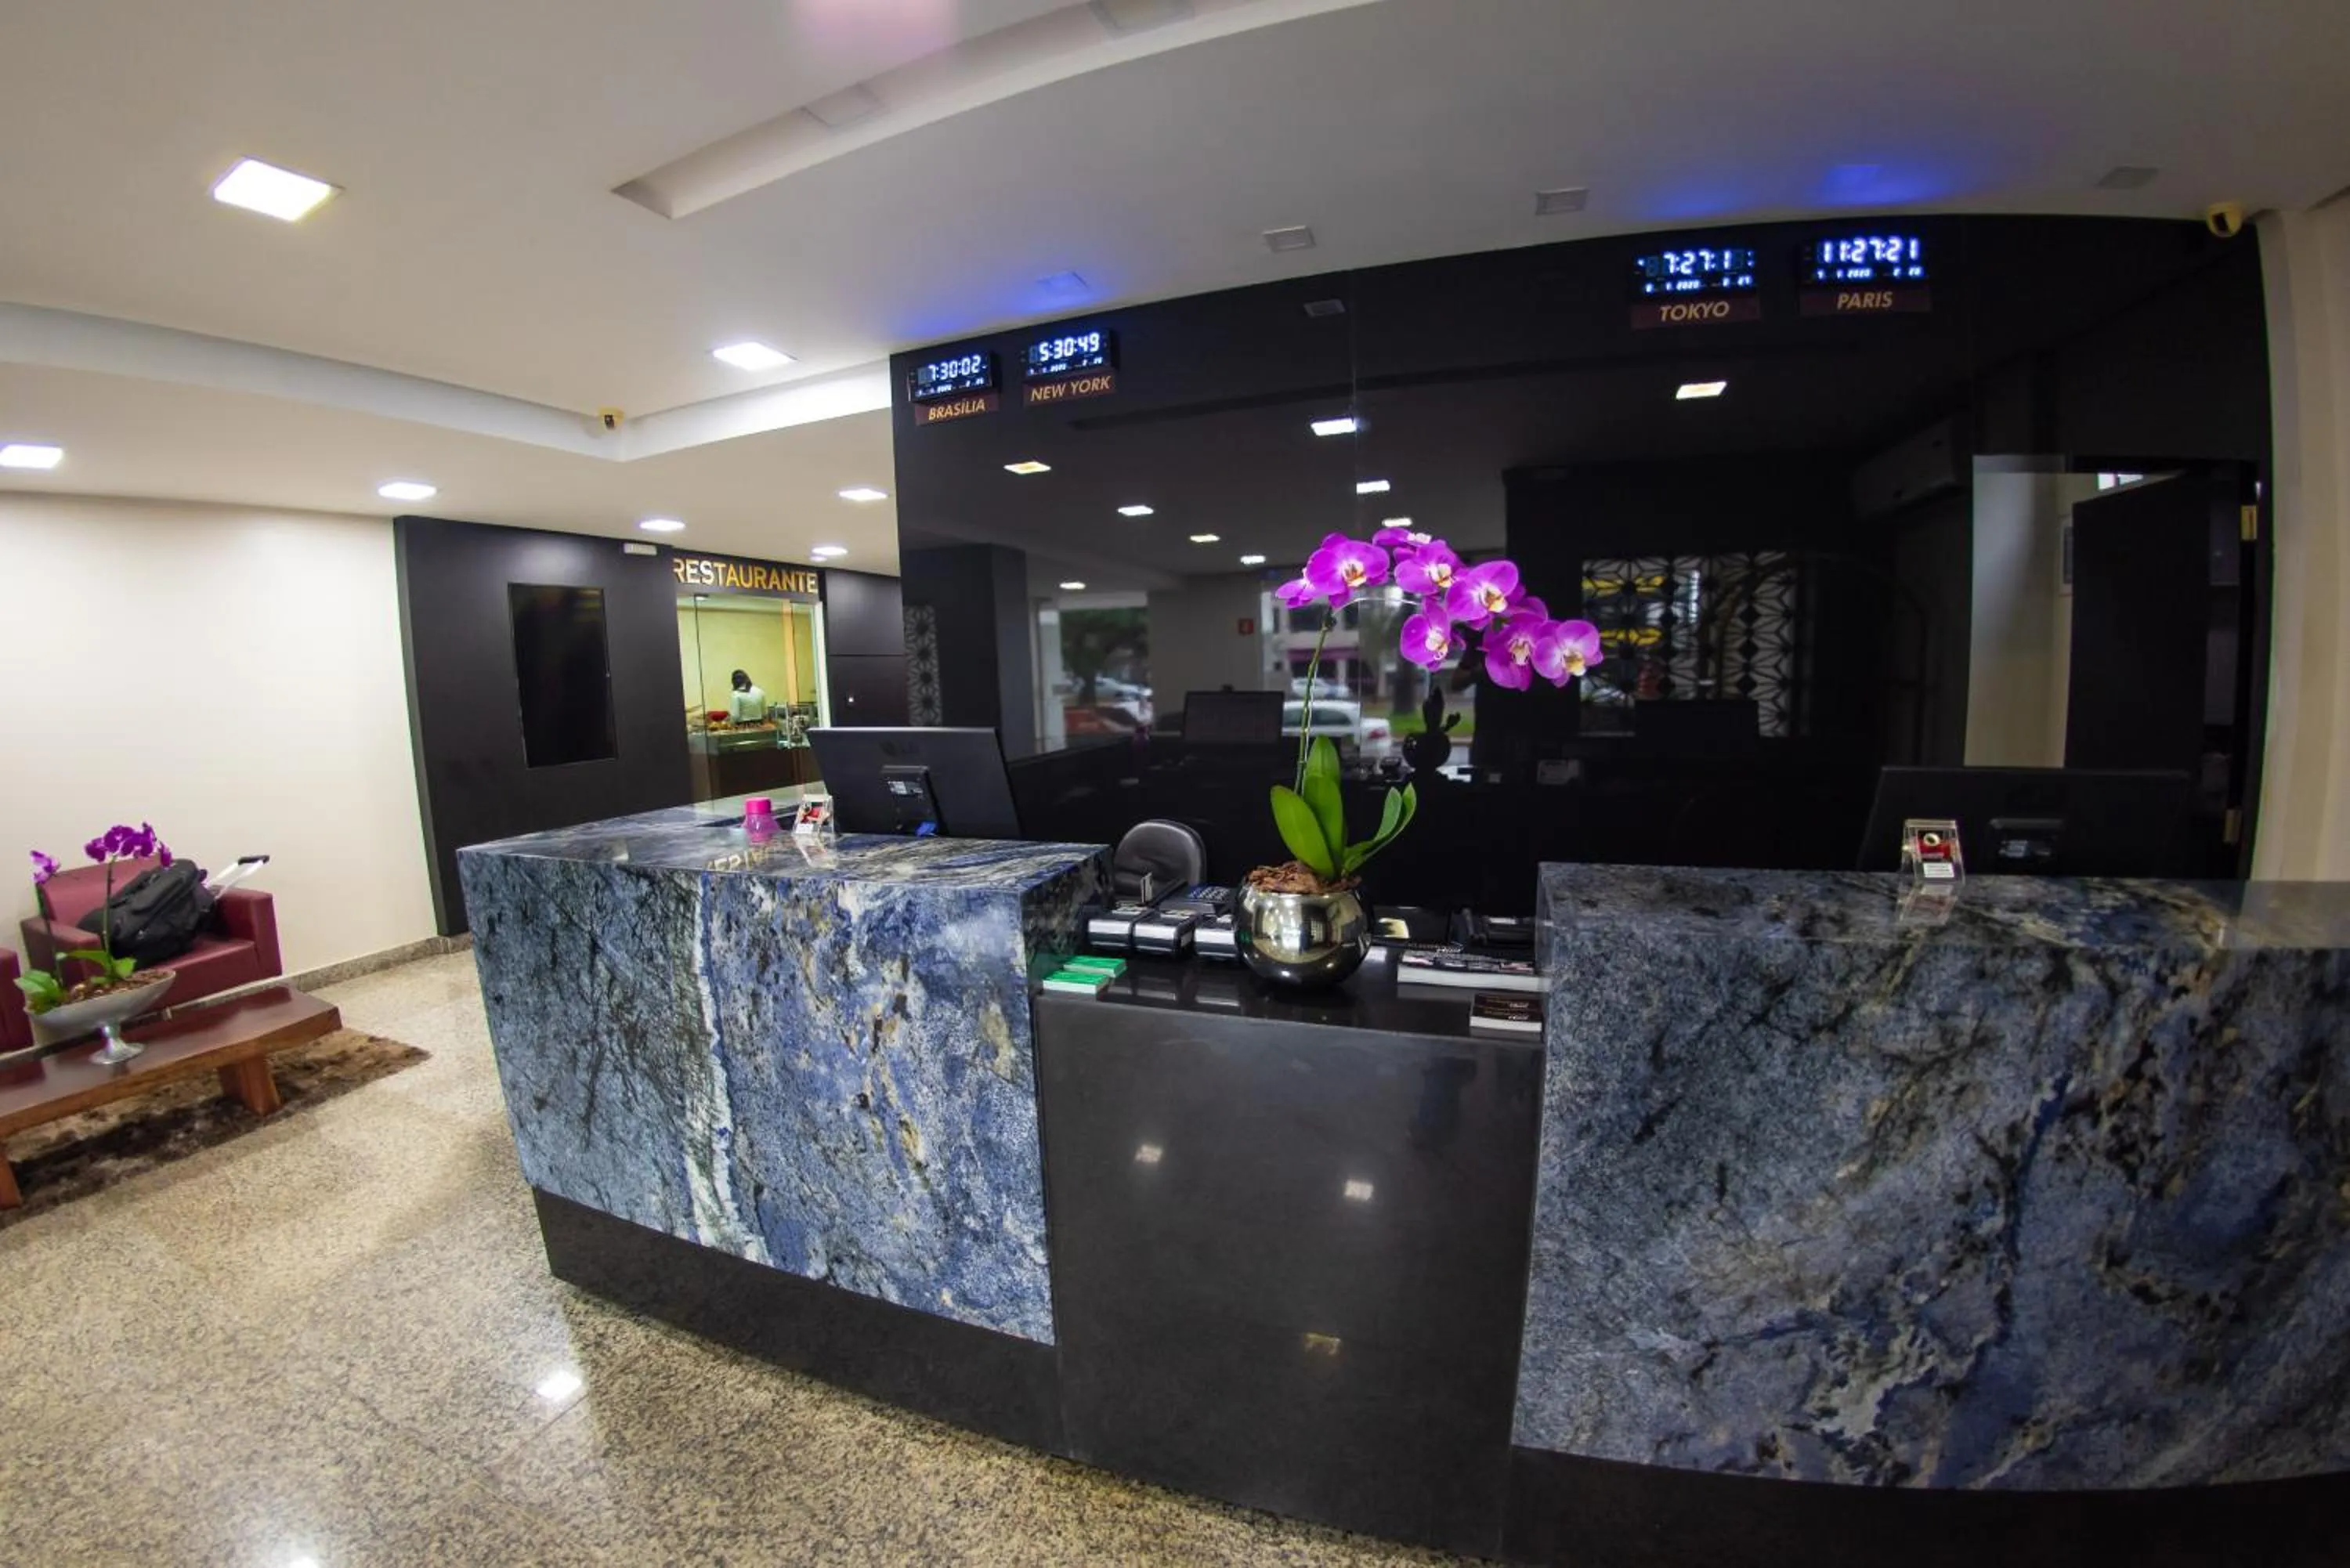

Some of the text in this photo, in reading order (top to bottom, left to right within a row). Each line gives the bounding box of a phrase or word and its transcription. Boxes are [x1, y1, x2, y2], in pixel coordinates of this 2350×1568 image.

[1660, 301, 1730, 322] TOKYO
[1837, 291, 1893, 309] PARIS
[1039, 332, 1100, 362] 5:30:49
[928, 355, 982, 381] 7:30:02
[1030, 376, 1111, 402] NEW YORK
[673, 558, 818, 594] RESTAURANTE
